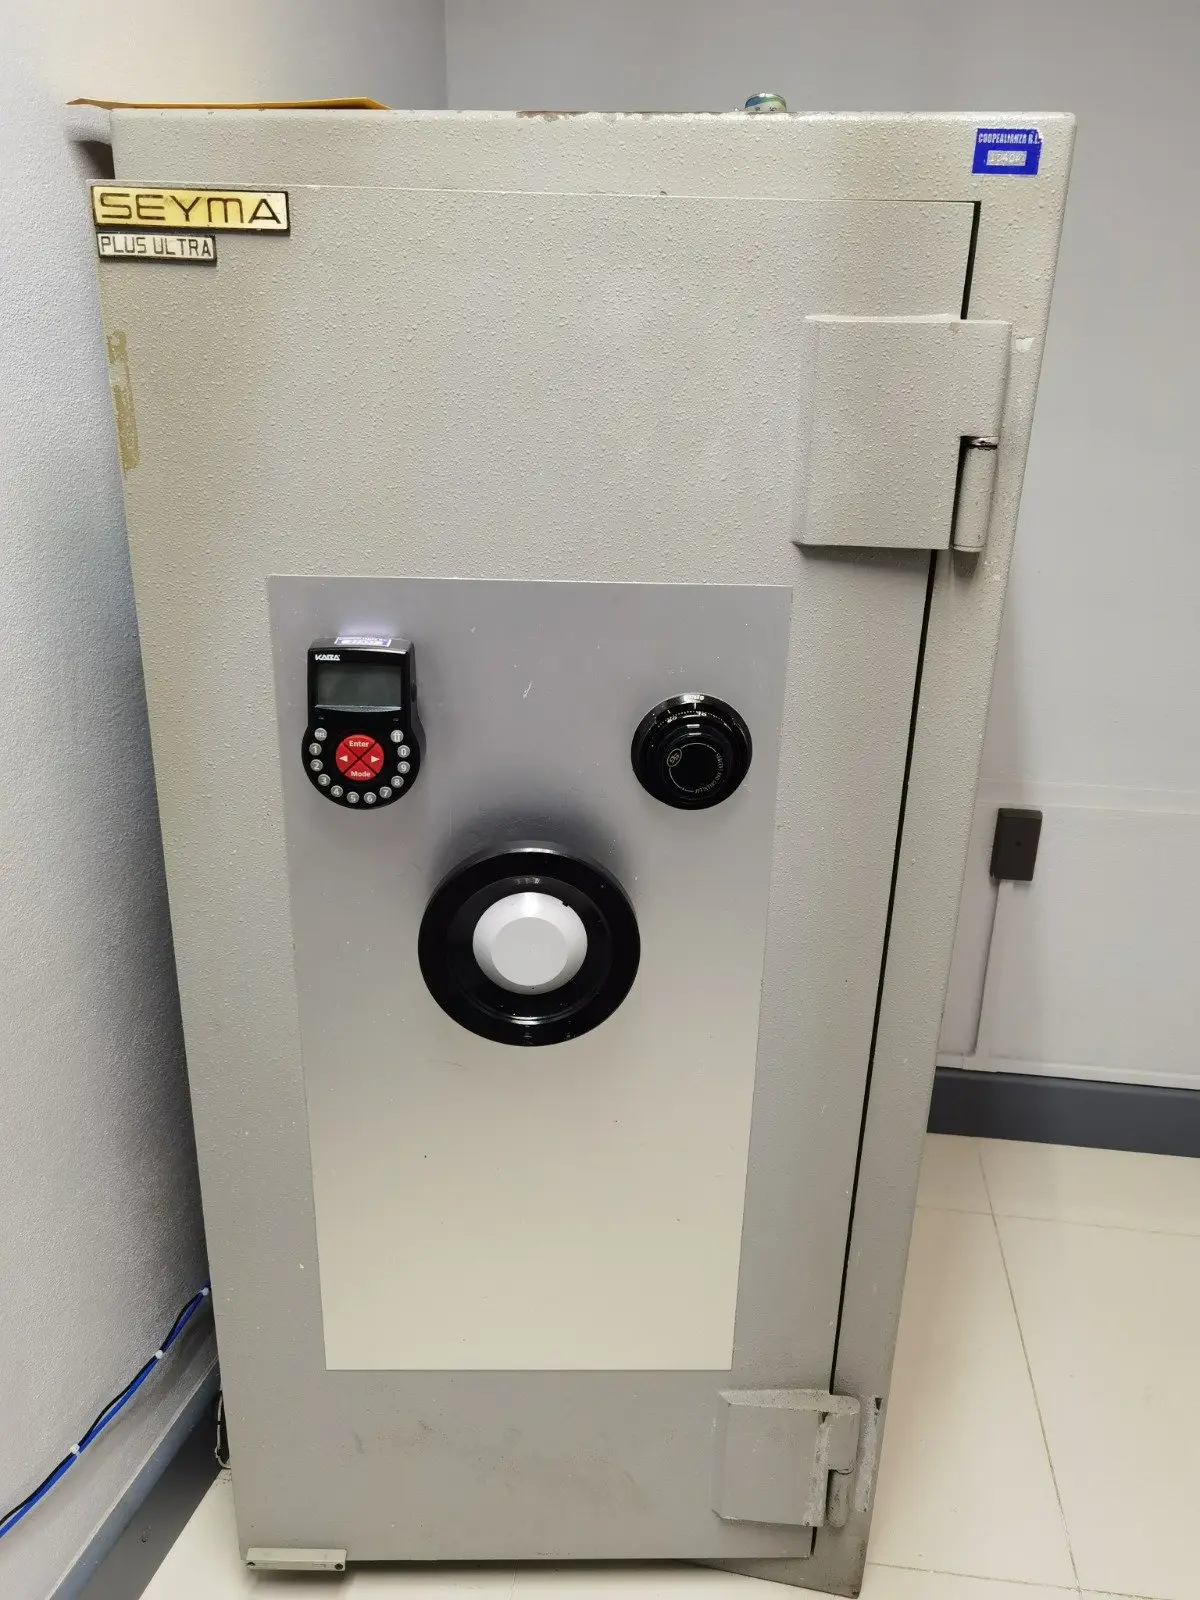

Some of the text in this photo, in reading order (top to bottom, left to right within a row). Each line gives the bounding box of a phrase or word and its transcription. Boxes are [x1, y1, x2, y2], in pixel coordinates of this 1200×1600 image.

[100, 192, 281, 225] SEYMA
[101, 235, 212, 257] PLUS ULTRA
